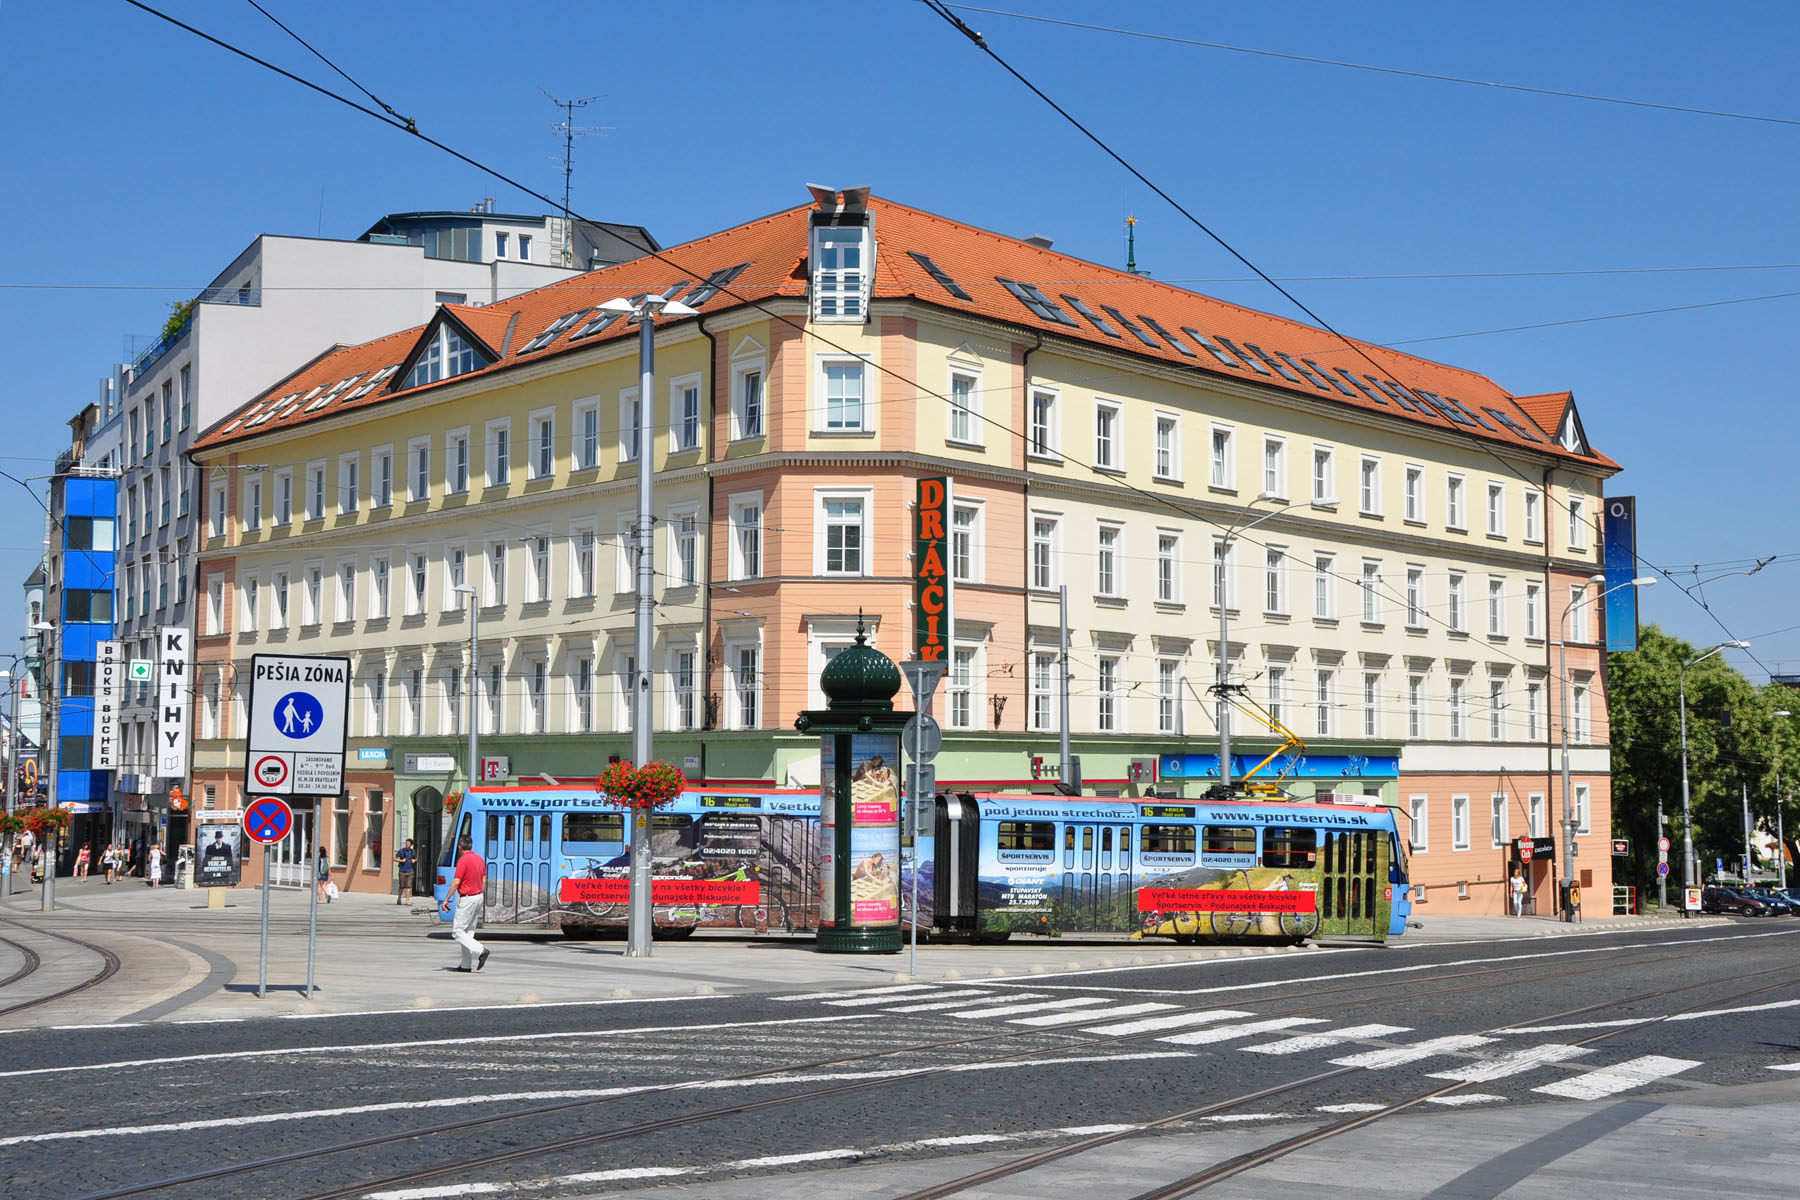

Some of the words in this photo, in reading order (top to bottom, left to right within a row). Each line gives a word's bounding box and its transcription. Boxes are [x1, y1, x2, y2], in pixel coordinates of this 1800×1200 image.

[103, 646, 113, 696] BOOKS
[256, 661, 301, 681] PEŠIA
[304, 663, 344, 683] ZÓNA
[164, 634, 184, 748] KNIHY
[361, 751, 386, 759] LEXON
[703, 796, 716, 807] 16
[769, 802, 820, 812] Všetko
[984, 807, 1009, 817] pod
[1011, 808, 1059, 818] jednou
[1143, 806, 1154, 817] 16
[1210, 811, 1369, 826] www.sportservis.sk
[575, 882, 602, 890] Veľké
[605, 882, 630, 890] letné
[674, 884, 705, 892] všetky
[580, 890, 630, 900] Športservi
[697, 893, 740, 902] Biskupice
[1178, 892, 1199, 900] letné
[1202, 893, 1224, 901] zľavy
[1240, 893, 1266, 901] všetky
[1156, 900, 1202, 910] Športservis
[1211, 902, 1256, 911] Podunajské
[1259, 902, 1296, 911] Biskupice
